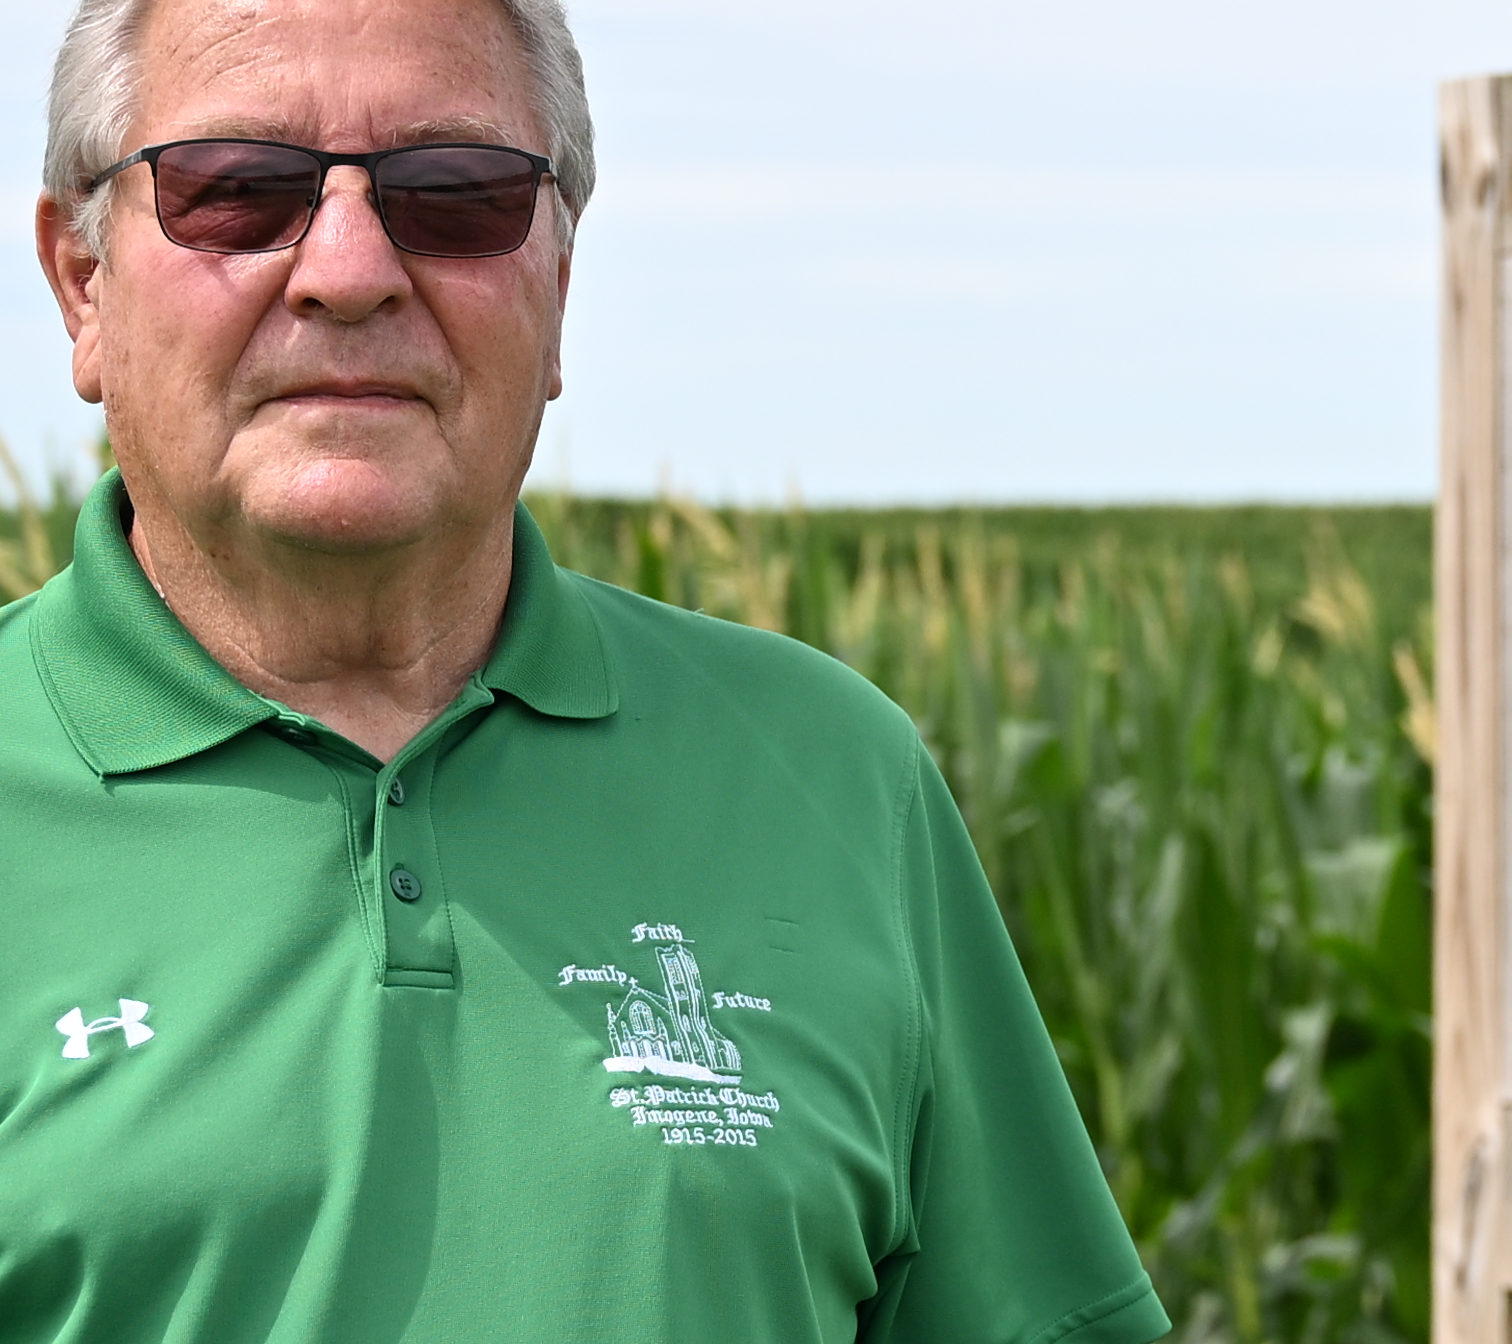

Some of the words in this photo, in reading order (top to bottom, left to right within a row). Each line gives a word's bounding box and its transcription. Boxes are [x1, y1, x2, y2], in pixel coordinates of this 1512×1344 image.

[631, 922, 683, 943] Faith
[558, 964, 627, 987] Family
[711, 991, 772, 1012] Future
[644, 1084, 719, 1105] Patrick
[719, 1087, 780, 1113] Church
[630, 1106, 724, 1127] Imogene,
[723, 1107, 774, 1128] Iowa
[661, 1127, 758, 1147] 1915-2015
